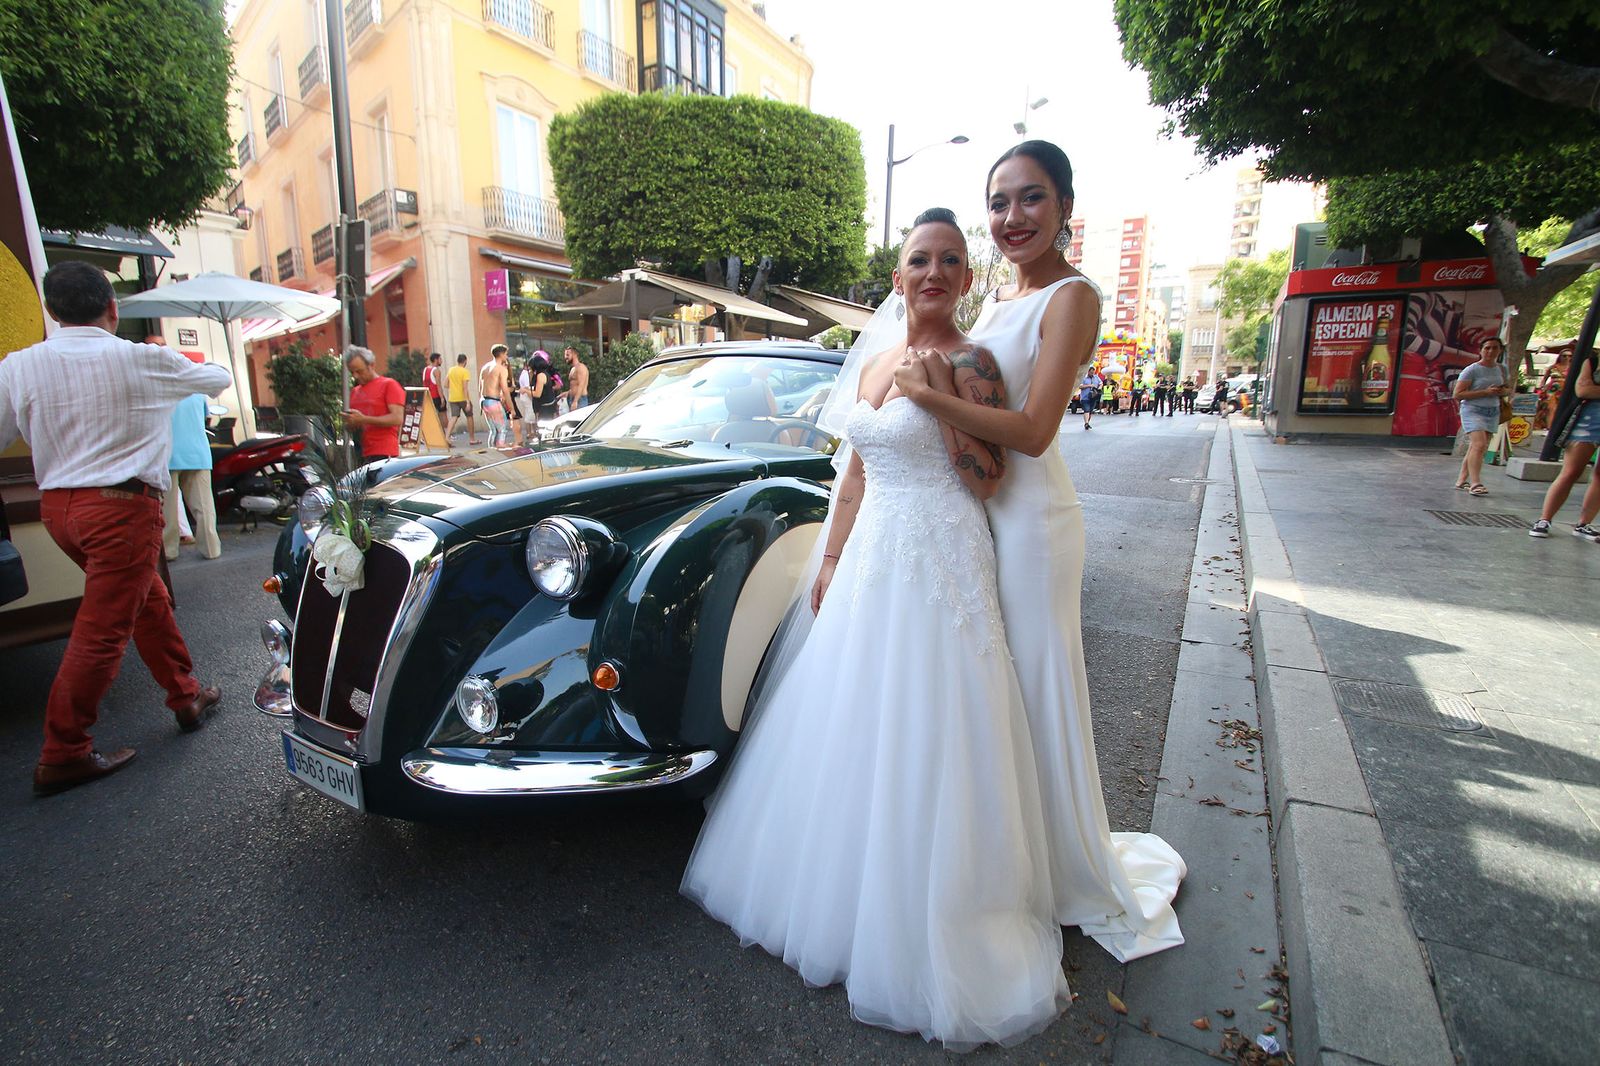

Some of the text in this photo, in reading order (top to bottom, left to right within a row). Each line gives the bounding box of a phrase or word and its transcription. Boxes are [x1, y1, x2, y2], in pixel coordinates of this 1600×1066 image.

[1316, 303, 1396, 323] ALMERÍA ES
[293, 748, 354, 797] 9563 GHV
